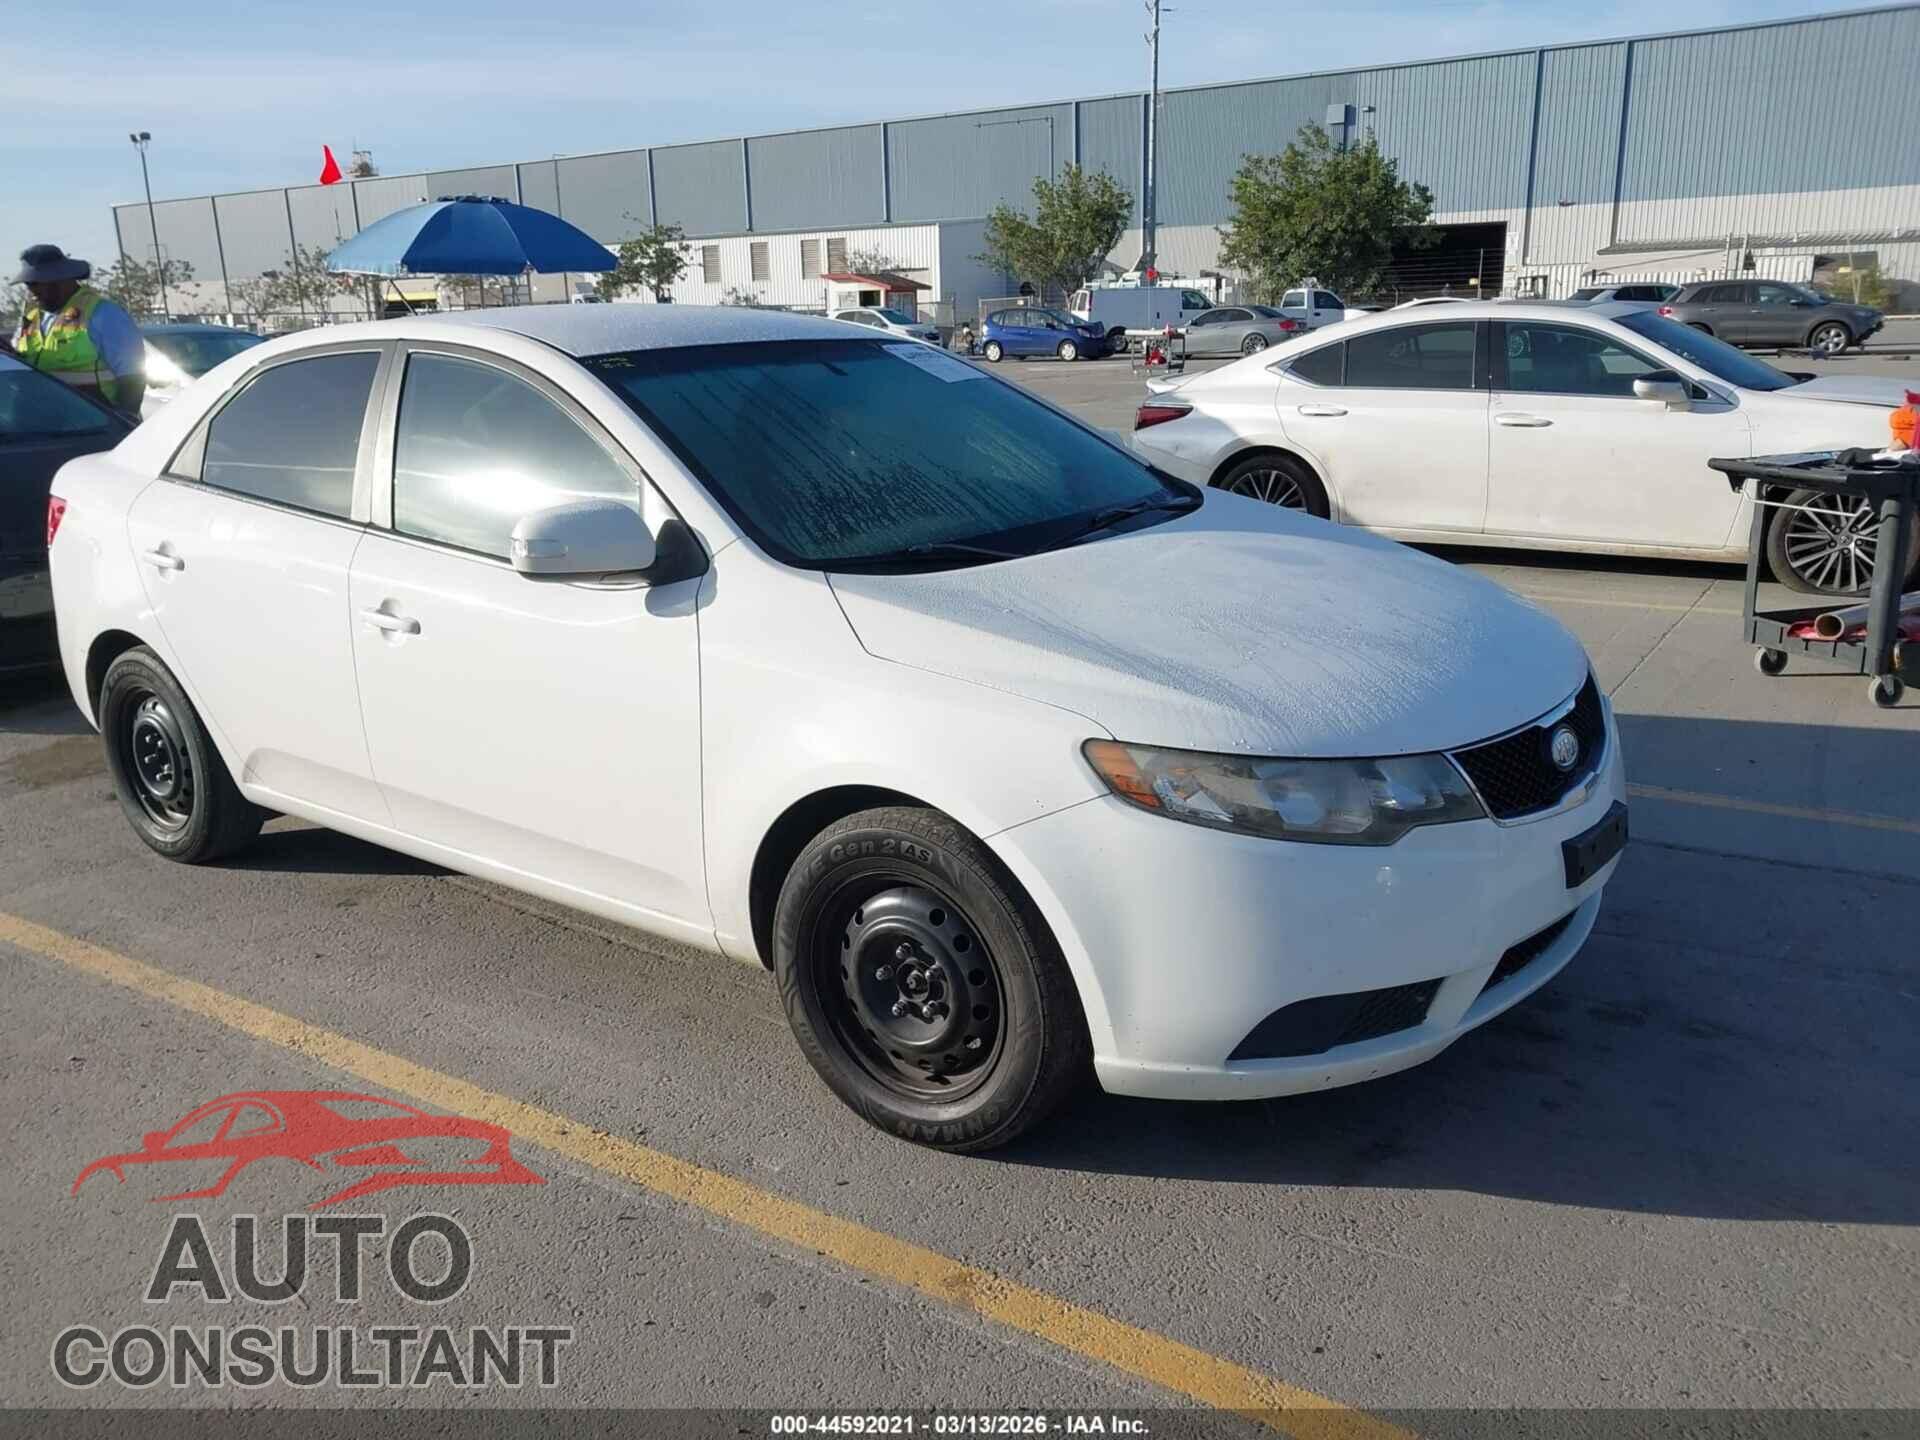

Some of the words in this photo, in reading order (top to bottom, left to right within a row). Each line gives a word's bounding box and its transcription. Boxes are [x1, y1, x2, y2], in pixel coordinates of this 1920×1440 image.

[830, 841, 875, 860] Gen
[882, 838, 896, 854] 2
[903, 843, 931, 863] AS
